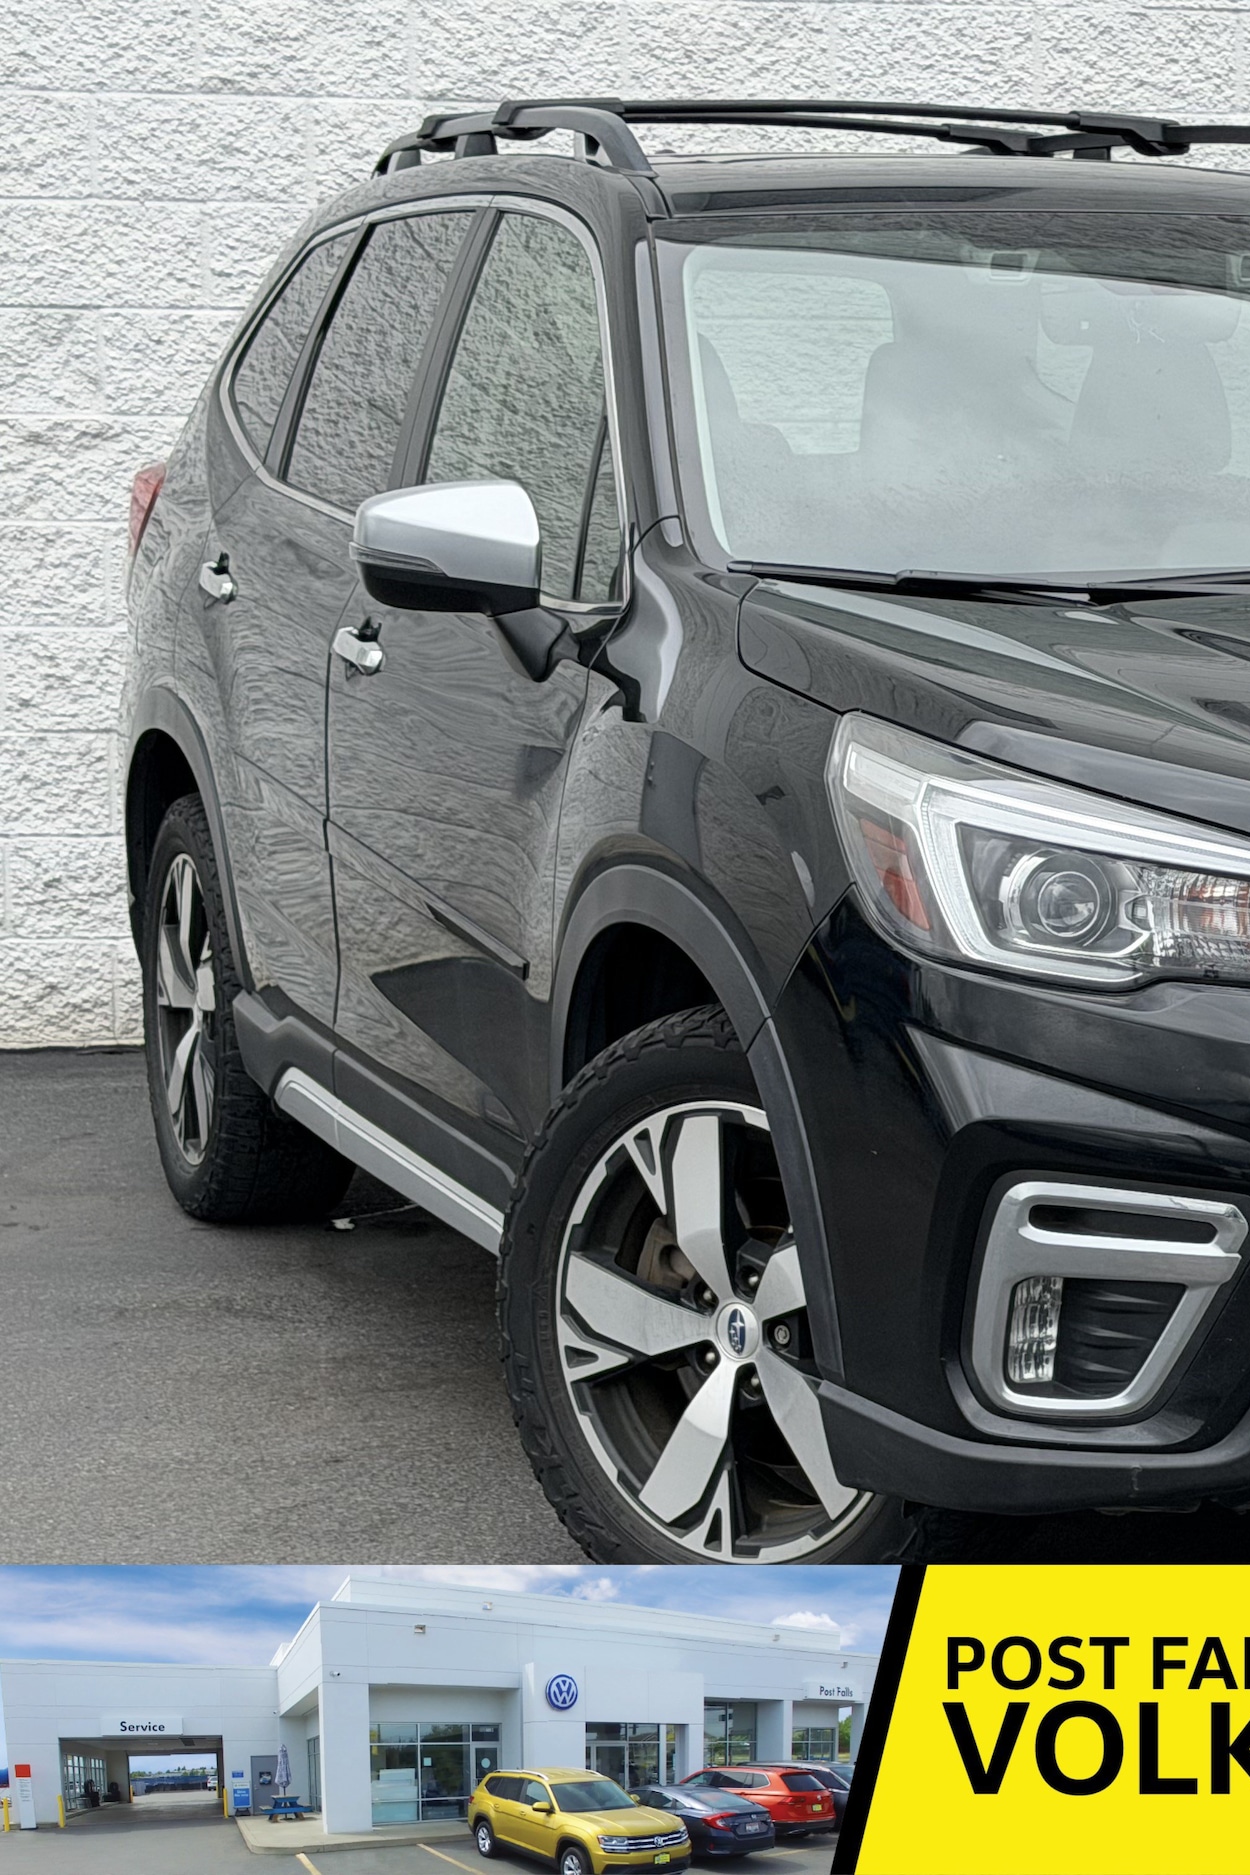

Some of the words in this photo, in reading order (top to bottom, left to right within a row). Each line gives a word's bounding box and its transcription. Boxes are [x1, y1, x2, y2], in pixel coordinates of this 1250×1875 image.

[819, 1685, 835, 1697] Post
[836, 1686, 854, 1698] Falls
[119, 1721, 166, 1733] Service
